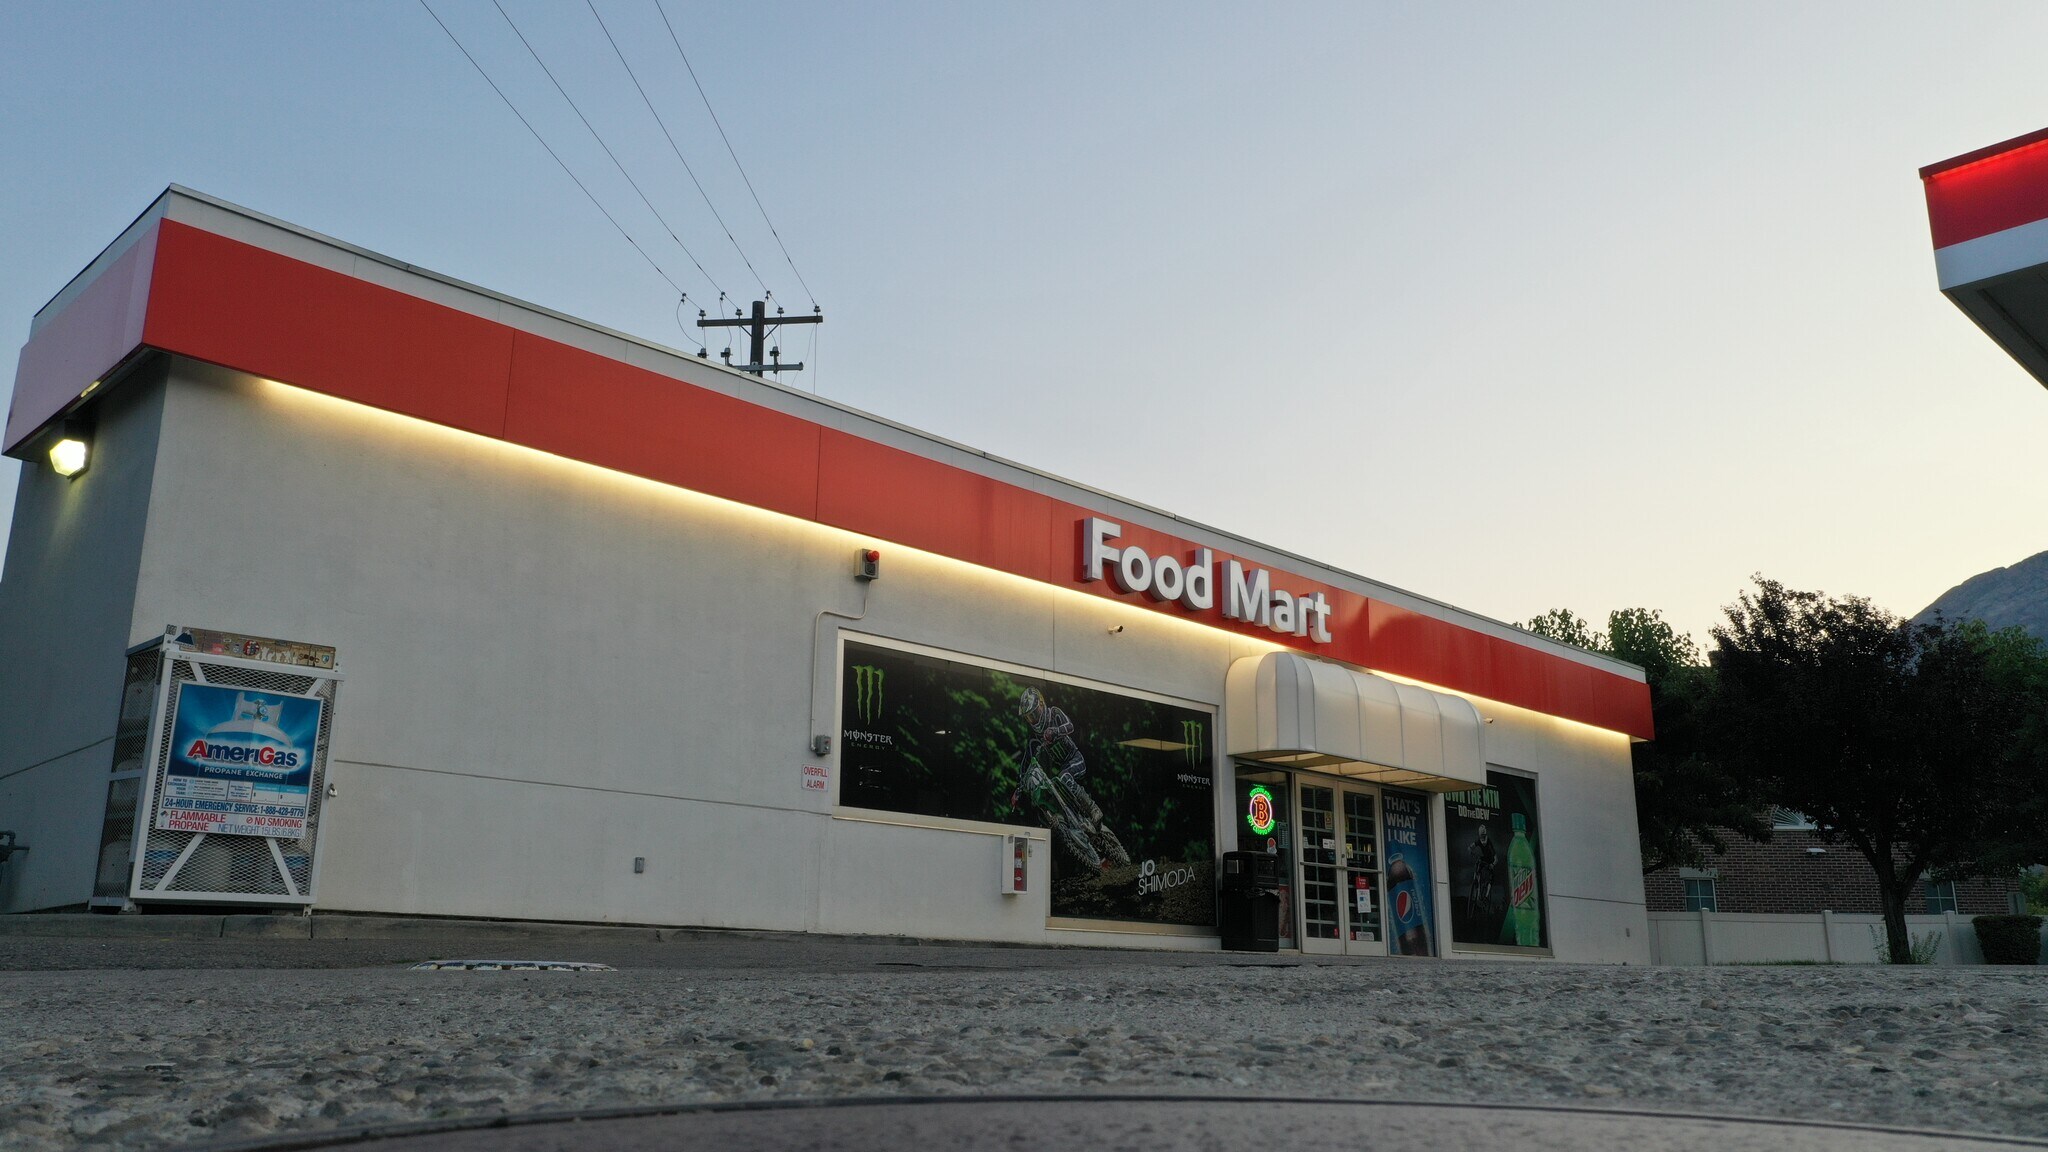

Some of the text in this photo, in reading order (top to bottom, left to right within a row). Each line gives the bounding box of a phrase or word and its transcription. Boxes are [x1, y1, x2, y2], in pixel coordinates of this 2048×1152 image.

[1083, 516, 1332, 643] Food Mart
[843, 729, 893, 745] MONSTER
[187, 739, 298, 767] AmeriGas
[851, 742, 886, 751] ENERGY
[204, 766, 283, 780] PROPANE EXCHANGE
[803, 766, 828, 778] OVERFILL
[1177, 773, 1211, 786] MONSTER
[806, 779, 825, 790] ALARM
[165, 798, 193, 809] 24-HOUR
[194, 800, 234, 812] EMERGENCY
[234, 803, 260, 814] SERVICE:
[1384, 795, 1421, 815] THAT'S
[170, 810, 227, 823] FLAMMABLE
[254, 816, 303, 829] NO SMOKING
[1386, 812, 1417, 830] WHAT
[168, 820, 210, 831] PROPANE
[218, 823, 234, 833] NET
[234, 825, 260, 835] WEIGHT
[1387, 828, 1417, 846] I LIKE
[1138, 859, 1155, 879] JO
[1138, 866, 1196, 896] SHIMODA
